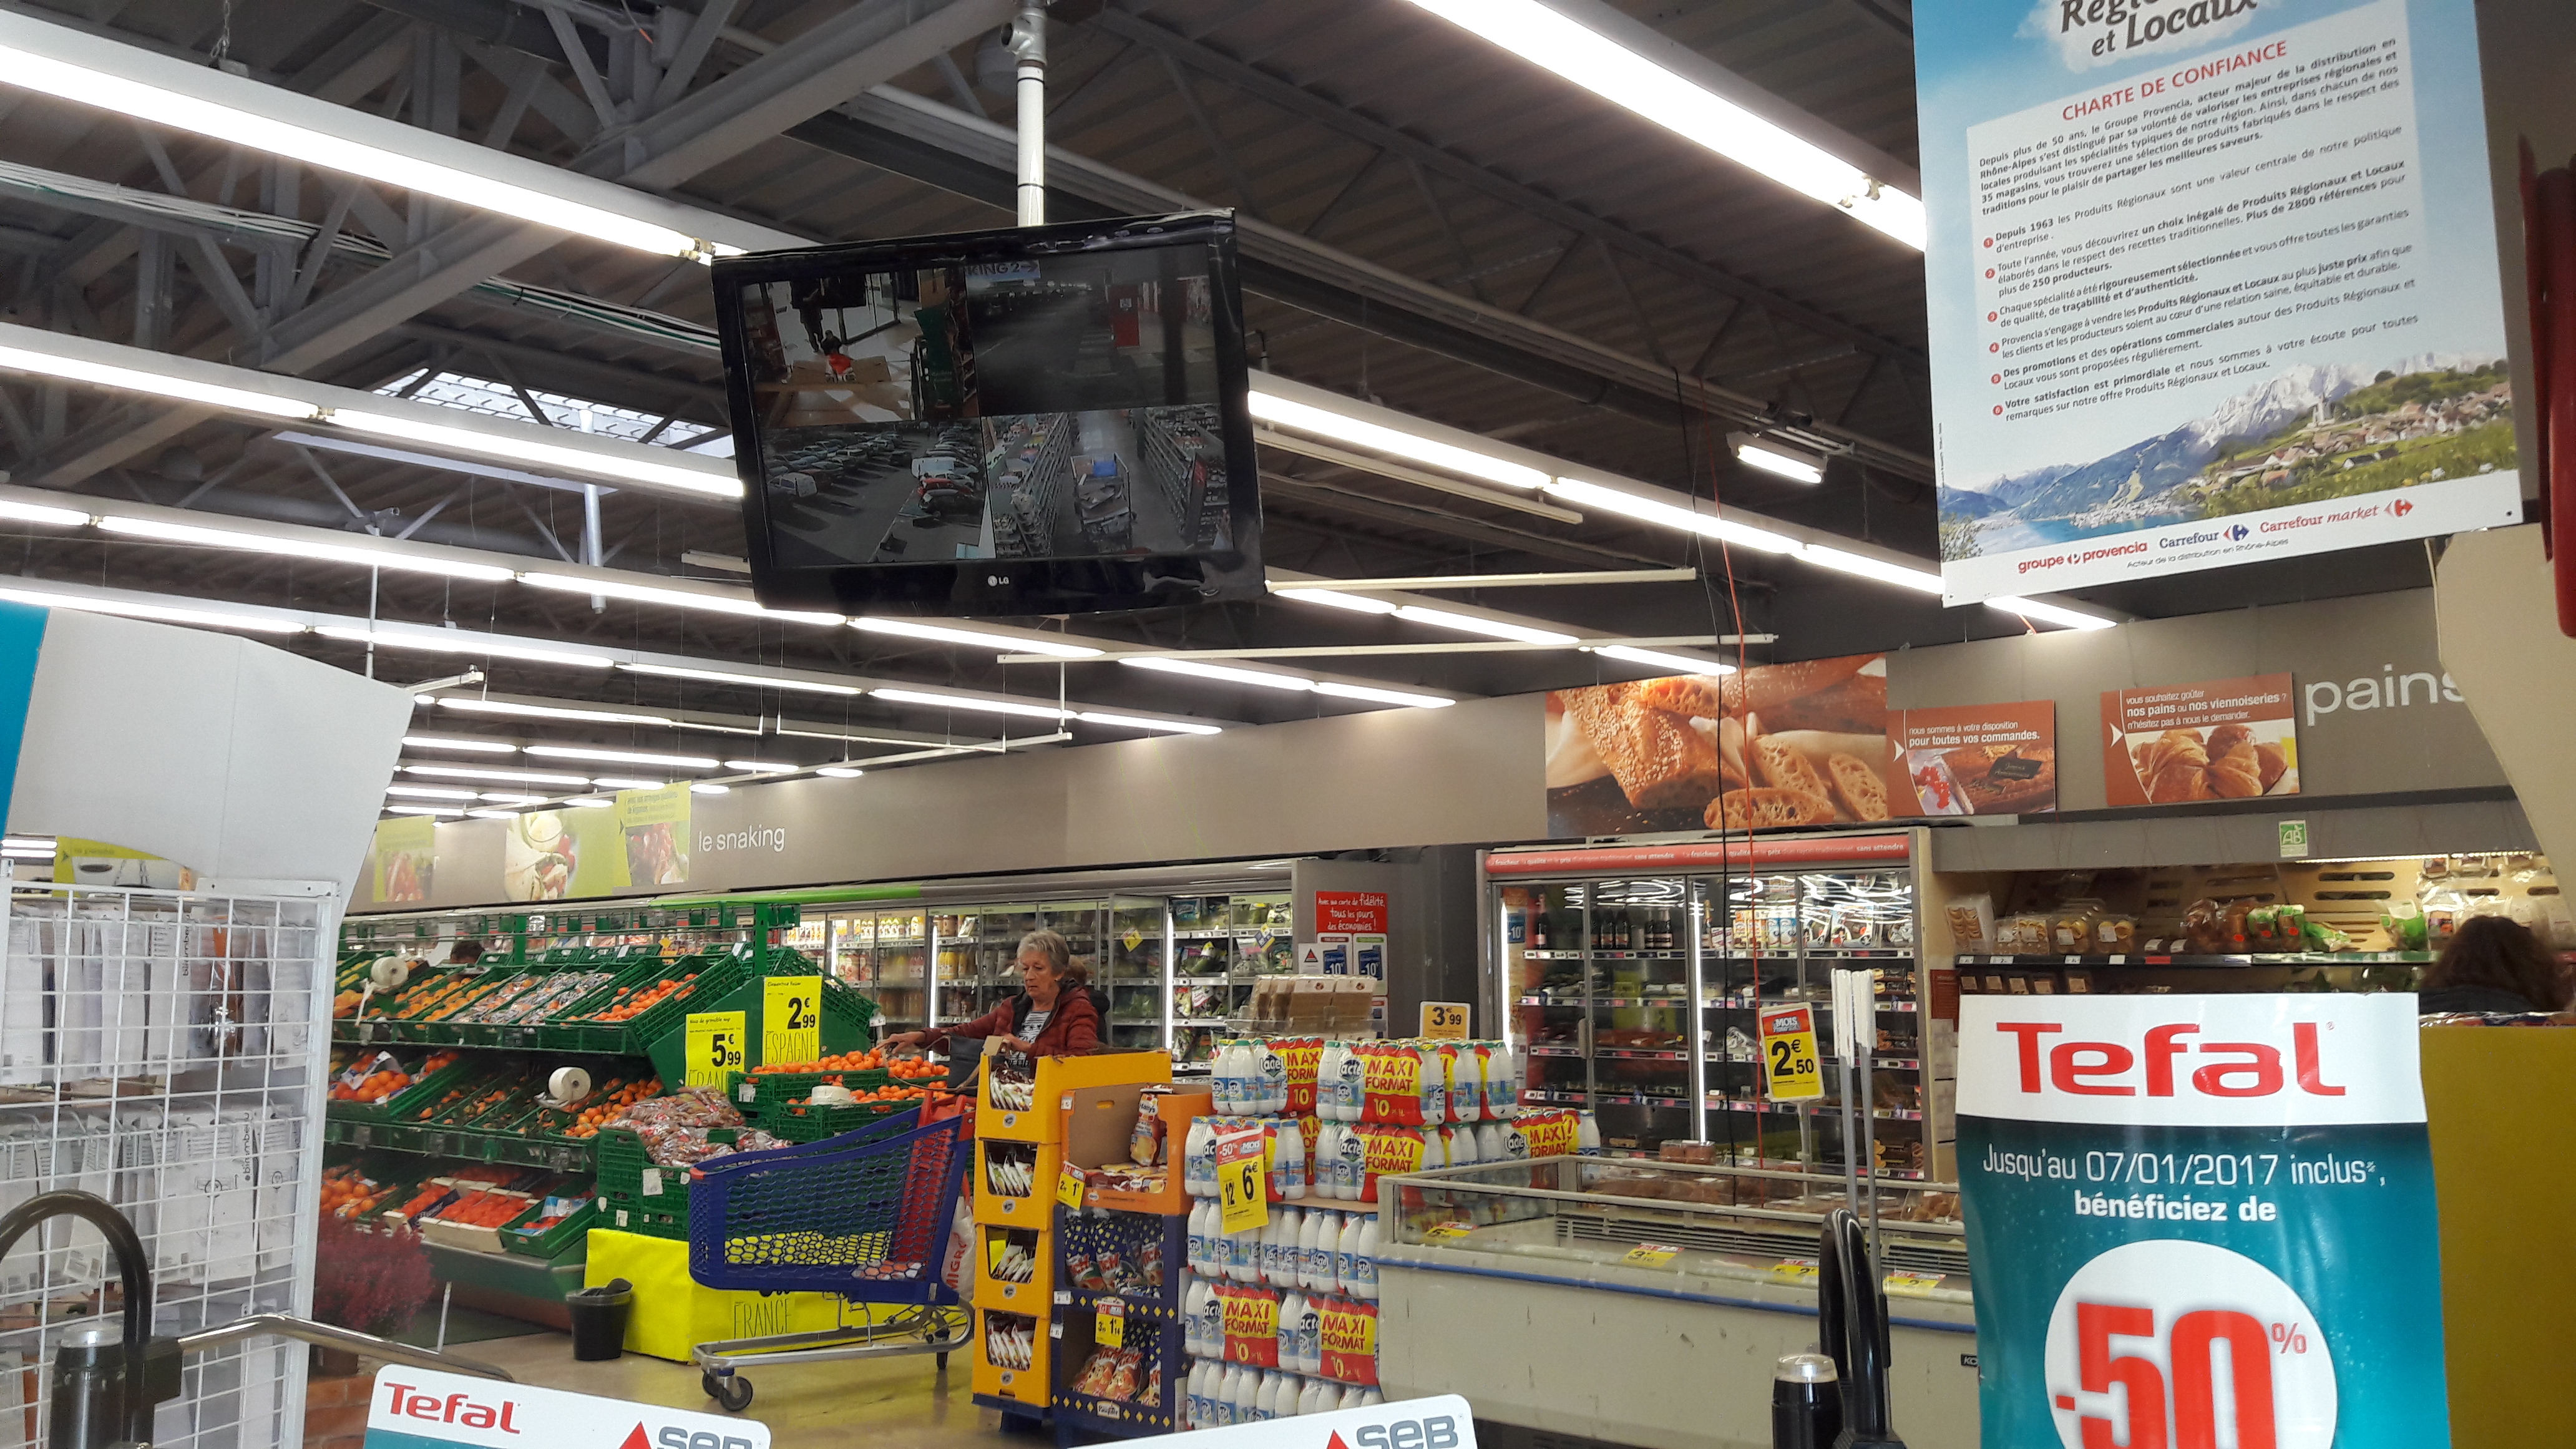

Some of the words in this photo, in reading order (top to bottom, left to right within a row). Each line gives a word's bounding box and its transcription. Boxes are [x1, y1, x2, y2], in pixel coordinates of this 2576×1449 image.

[2092, 29, 2116, 57] et
[2063, 87, 2135, 121] CHARTE
[2140, 77, 2166, 99] DE
[2172, 39, 2288, 88] CONFIANCE
[1979, 150, 2009, 168] Depuis
[2012, 144, 2032, 159] plus
[2036, 139, 2047, 150] de
[2052, 134, 2064, 145] 50
[2068, 129, 2087, 142] ans,
[2091, 124, 2100, 134] le
[2104, 112, 2138, 132] Groupe
[2143, 96, 2192, 120] Provencia,
[2197, 86, 2230, 103] acteur
[2235, 74, 2271, 94] majeur
[2276, 67, 2290, 80] de
[2295, 63, 2305, 74] la
[2310, 42, 2376, 70] distribution
[2381, 39, 2396, 49] en
[1982, 195, 2026, 215] traditions
[2028, 190, 2049, 204] pour
[2051, 186, 2059, 196] le
[2061, 177, 2089, 195] plaisir
[2091, 173, 2103, 185] de
[2105, 162, 2147, 183] partager
[2149, 157, 2163, 168] les
[2165, 142, 2217, 164] meilleures
[2220, 131, 2262, 149] saveurs.
[1998, 284, 2017, 298] plus
[2018, 281, 2030, 291] de
[2032, 276, 2050, 288] 250
[2052, 260, 2112, 285] producteurs.
[2000, 316, 2011, 327] de
[2013, 308, 2046, 325] qualité,
[2048, 305, 2060, 315] de
[2062, 293, 2110, 314] traçabilité
[2112, 291, 2123, 300] et
[2125, 271, 2198, 297] d'authenticité.
[2004, 375, 2034, 389] Locaux
[2036, 372, 2057, 383] vous
[2059, 366, 2079, 378] sont
[2081, 354, 2129, 374] proposées
[2131, 339, 2202, 364] régulièrement.
[2006, 405, 2054, 422] remarques
[2056, 402, 2070, 411] sur
[2072, 395, 2097, 407] notre
[2099, 389, 2122, 401] offre
[2125, 380, 2165, 396] Produits
[2167, 369, 2218, 389] Régionaux
[2220, 367, 2231, 376] et
[2233, 358, 2270, 374] Locaux.
[2260, 514, 2323, 534] Carrefour
[2326, 503, 2379, 524] market
[2160, 532, 2220, 549] Carrefour
[2018, 554, 2064, 575] groupe
[2082, 540, 2149, 565] provencia
[998, 576, 1010, 585] LG
[2126, 696, 2144, 705] vous
[2145, 692, 2179, 703] souhaitez
[2181, 689, 2205, 701] goûter
[2127, 707, 2146, 718] nos
[2147, 703, 2176, 717] pains
[2177, 704, 2187, 713] ou
[2188, 700, 2208, 713] nos
[2210, 693, 2280, 709] viennoiseries
[1909, 726, 1926, 736] nous
[1927, 724, 1956, 734] sommes
[1963, 723, 1981, 732] votre
[1982, 720, 2019, 733] disposition
[2127, 719, 2160, 729] n'hésitez
[2160, 718, 2175, 728] pas
[2183, 715, 2201, 725] nous
[2202, 713, 2209, 723] le
[2210, 710, 2251, 721] demander.
[1909, 736, 1930, 749] pour
[1932, 734, 1961, 746] toutes
[1963, 734, 1979, 743] vos
[1981, 729, 2041, 743] commandes.
[698, 831, 713, 852] le
[716, 824, 786, 852] snaking
[1330, 907, 1346, 918] tous
[1327, 922, 1337, 930] des
[1338, 920, 1372, 931] économies
[803, 1014, 816, 1028] 99
[765, 1030, 816, 1065] ESPAGNE
[728, 1050, 741, 1066] 99
[1287, 1051, 1323, 1066] MAX
[1796, 1058, 1815, 1074] 50
[1997, 1022, 2346, 1097] Tefal
[1287, 1066, 1319, 1080] FORM
[1339, 1060, 1365, 1076] lactel
[1366, 1059, 1415, 1078] MAXI
[1365, 1076, 1413, 1092] FORMAT
[1373, 1098, 1391, 1117] 10
[1528, 1128, 1566, 1145] MAXI
[1337, 1138, 1365, 1156] lactel
[1366, 1139, 1415, 1158] MAXI
[1529, 1142, 1568, 1157] FORMAT
[1365, 1157, 1414, 1173] FORMAT
[1983, 1144, 2077, 1182] Jusqu'au
[2085, 1150, 2279, 1186] 07/01/2017
[2074, 1189, 2228, 1221] bénéficiez
[2238, 1195, 2277, 1221] de
[733, 1298, 792, 1340] FRANCE
[1225, 1301, 1271, 1320] MAXI
[1224, 1318, 1270, 1334] FORMAT
[1322, 1314, 1365, 1336] MAXI
[1234, 1341, 1249, 1362] 10
[1321, 1332, 1365, 1351] FORMAT
[384, 1382, 520, 1434] Tefal
